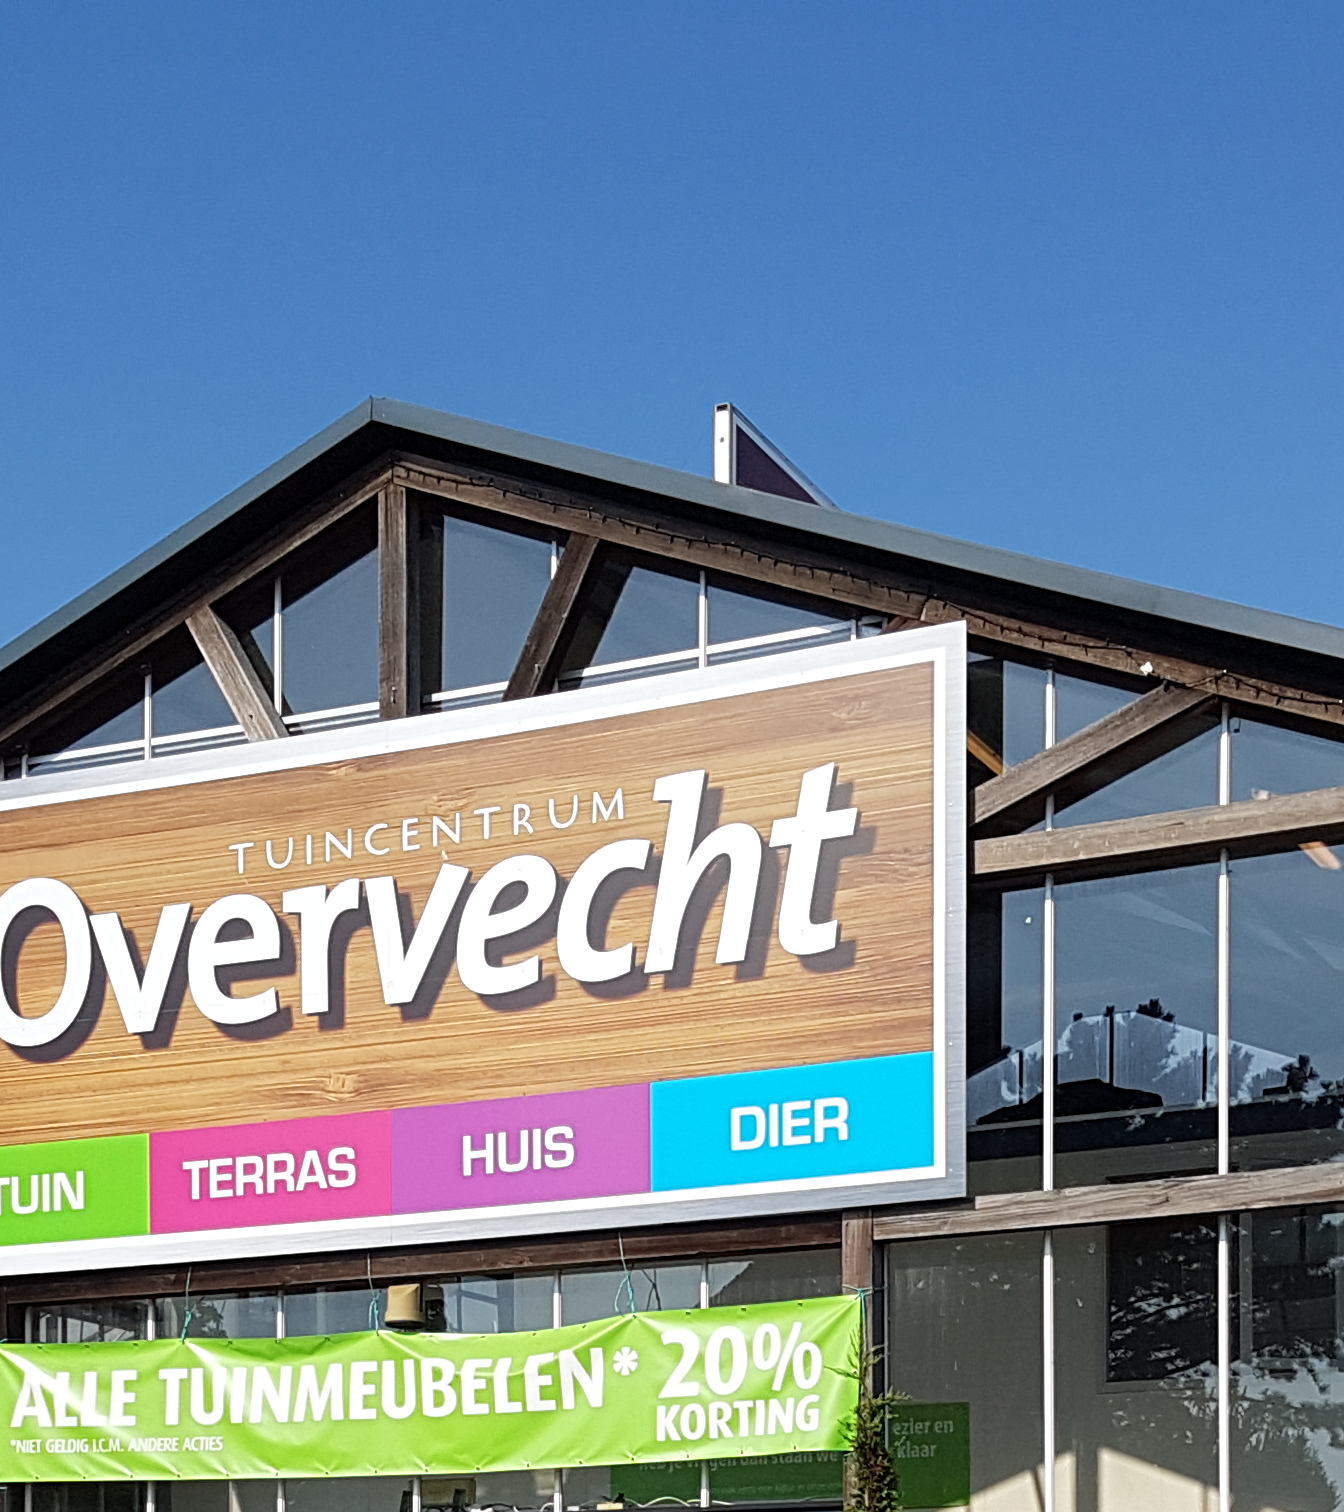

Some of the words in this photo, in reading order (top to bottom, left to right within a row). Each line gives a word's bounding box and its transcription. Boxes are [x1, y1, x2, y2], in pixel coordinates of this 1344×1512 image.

[228, 786, 627, 876] TUINCENTRUM
[460, 1125, 576, 1178] HUIS
[729, 1096, 850, 1152] DIER
[182, 1145, 358, 1200] TERRAS
[657, 1322, 824, 1401] 20%
[9, 1368, 137, 1429] ALLE
[655, 1394, 820, 1442] KORTING
[46, 1438, 89, 1454] GELDIG
[128, 1437, 179, 1452] ANDERE
[183, 1436, 224, 1452] ACTIES
[893, 1418, 931, 1435] ezier
[934, 1420, 954, 1434] en
